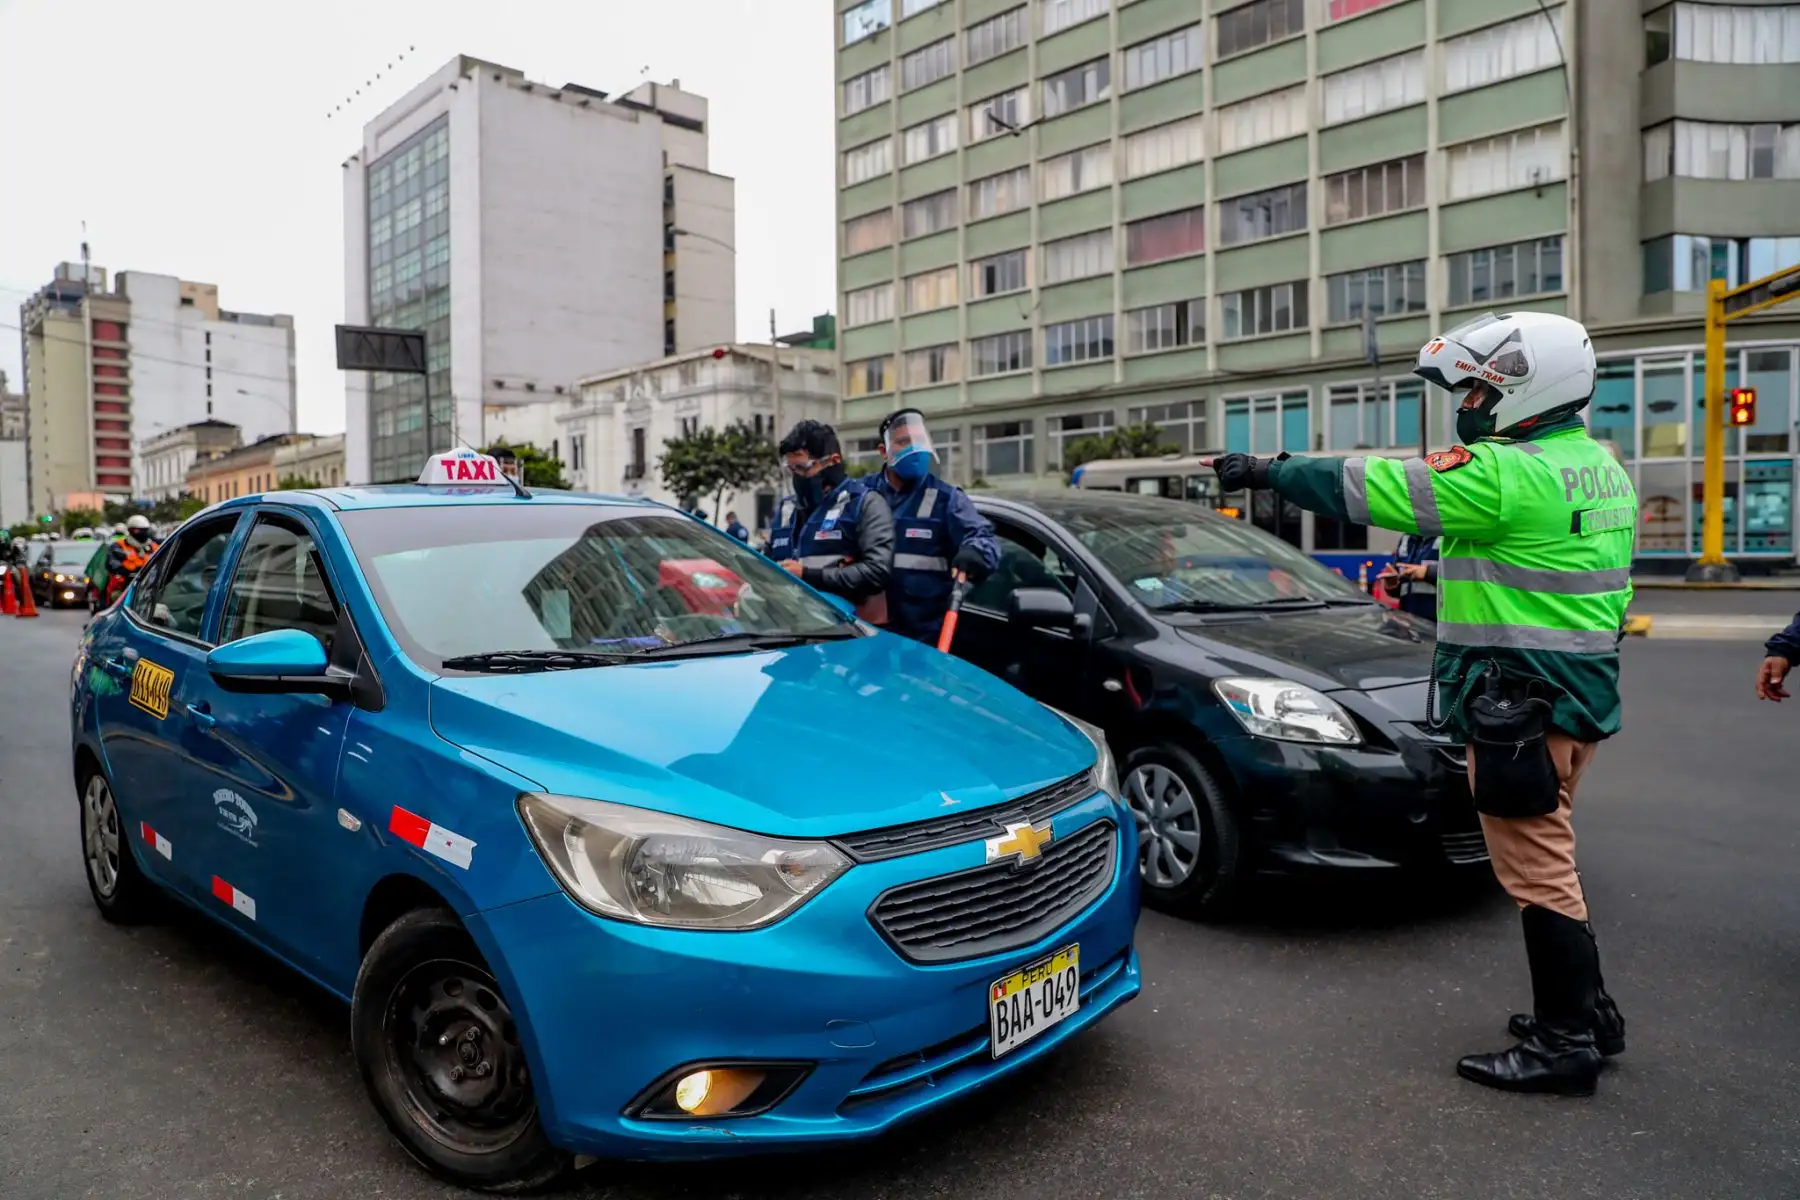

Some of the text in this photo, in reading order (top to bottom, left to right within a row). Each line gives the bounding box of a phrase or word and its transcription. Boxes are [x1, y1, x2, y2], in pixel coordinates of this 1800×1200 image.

[441, 460, 496, 480] TAXI
[1560, 465, 1632, 502] POLICIA
[132, 663, 171, 713] BAA-049
[1022, 961, 1053, 986] PERU
[996, 965, 1077, 1045] BAA-049
